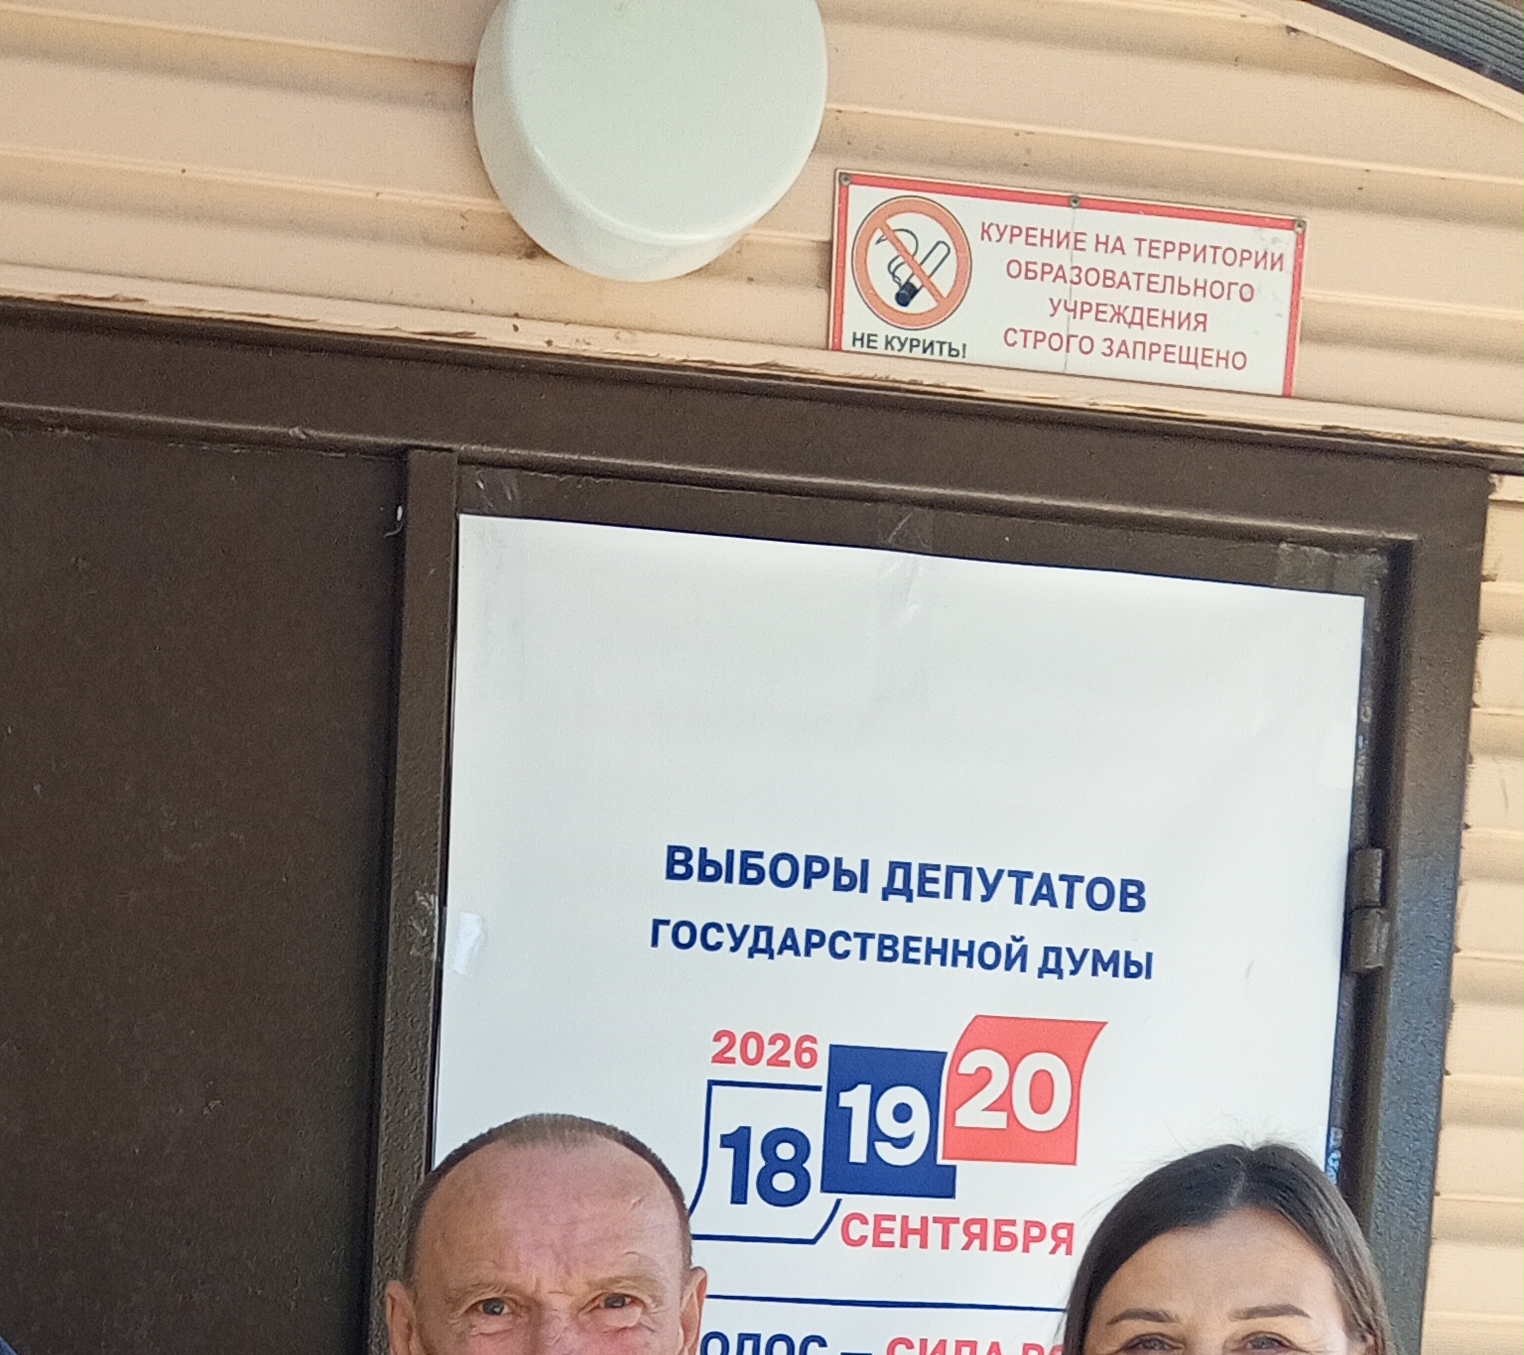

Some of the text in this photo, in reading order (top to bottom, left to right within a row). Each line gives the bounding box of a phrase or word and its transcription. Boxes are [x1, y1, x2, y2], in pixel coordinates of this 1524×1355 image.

[980, 221, 1285, 272] КУРЕНИЕ НА ТЕРРИТОРИИ
[1006, 259, 1255, 303] ОБРАЗОВАТЕЛЬНОГО
[1049, 297, 1208, 333] УЧРЕЖДЕНИЯ
[851, 331, 968, 359] НЕ КУРИТЬ!
[1003, 327, 1247, 371] СТРОГО ЗАПРЕЩЕНО
[664, 844, 1147, 914] ВЫБОРЫ ДЕПУТАТОВ
[650, 918, 1154, 980] ГОСУДАРСТВЕННОЙ ДУМЫ
[710, 1029, 818, 1070] 2026
[719, 1048, 1073, 1208] 18 19 20
[840, 1212, 1074, 1256] СЕНТЯБРЯ
